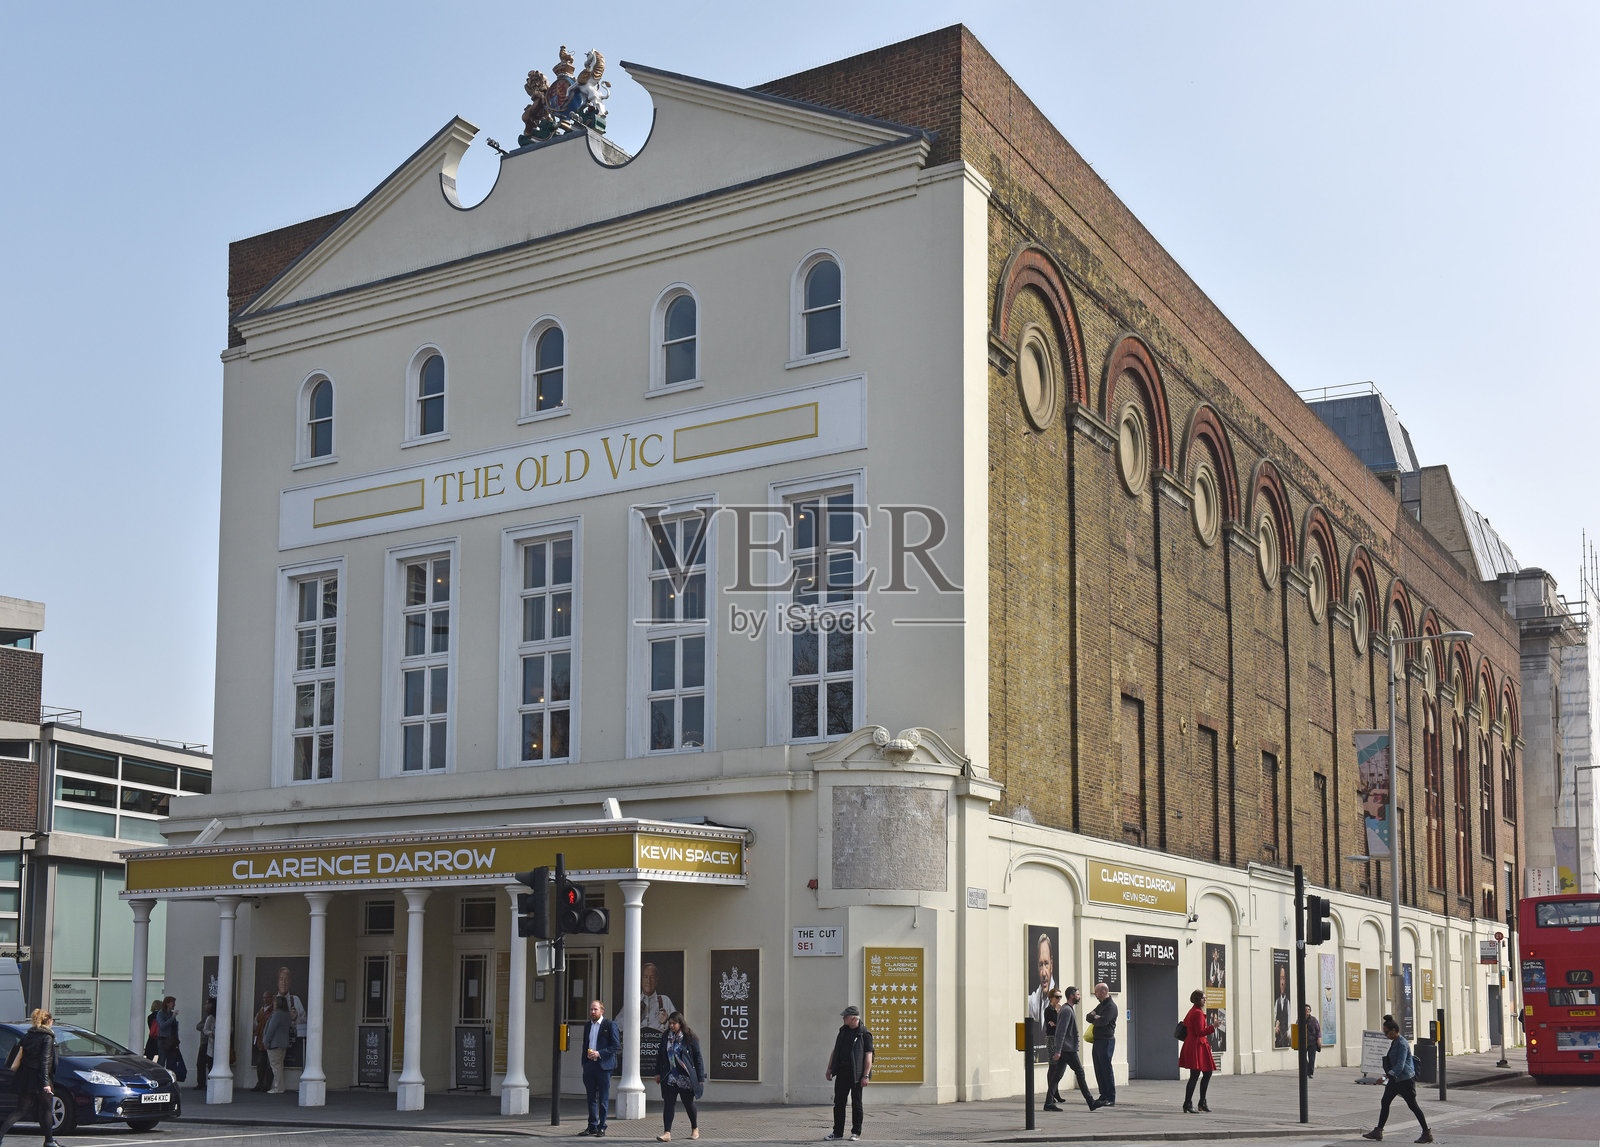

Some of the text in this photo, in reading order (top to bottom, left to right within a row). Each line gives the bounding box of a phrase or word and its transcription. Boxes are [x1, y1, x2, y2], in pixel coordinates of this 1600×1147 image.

[434, 463, 505, 506] THE
[515, 448, 590, 491] OLD
[640, 845, 738, 865] KEVIN SPACEY
[232, 847, 496, 880] CLARENCE DARROW
[1101, 868, 1177, 894] CLARENCE DARROW
[1122, 891, 1159, 905] KEVIN SPACEY
[797, 929, 837, 939] THE CUT
[797, 941, 814, 951] SE1
[1097, 950, 1117, 960] PIT BAR
[1144, 944, 1157, 958] PIT
[1157, 945, 1175, 960] BAR
[1571, 971, 1588, 982] 172
[721, 1005, 748, 1016] THE
[720, 1017, 749, 1028] OLD
[721, 1030, 748, 1040] VIC
